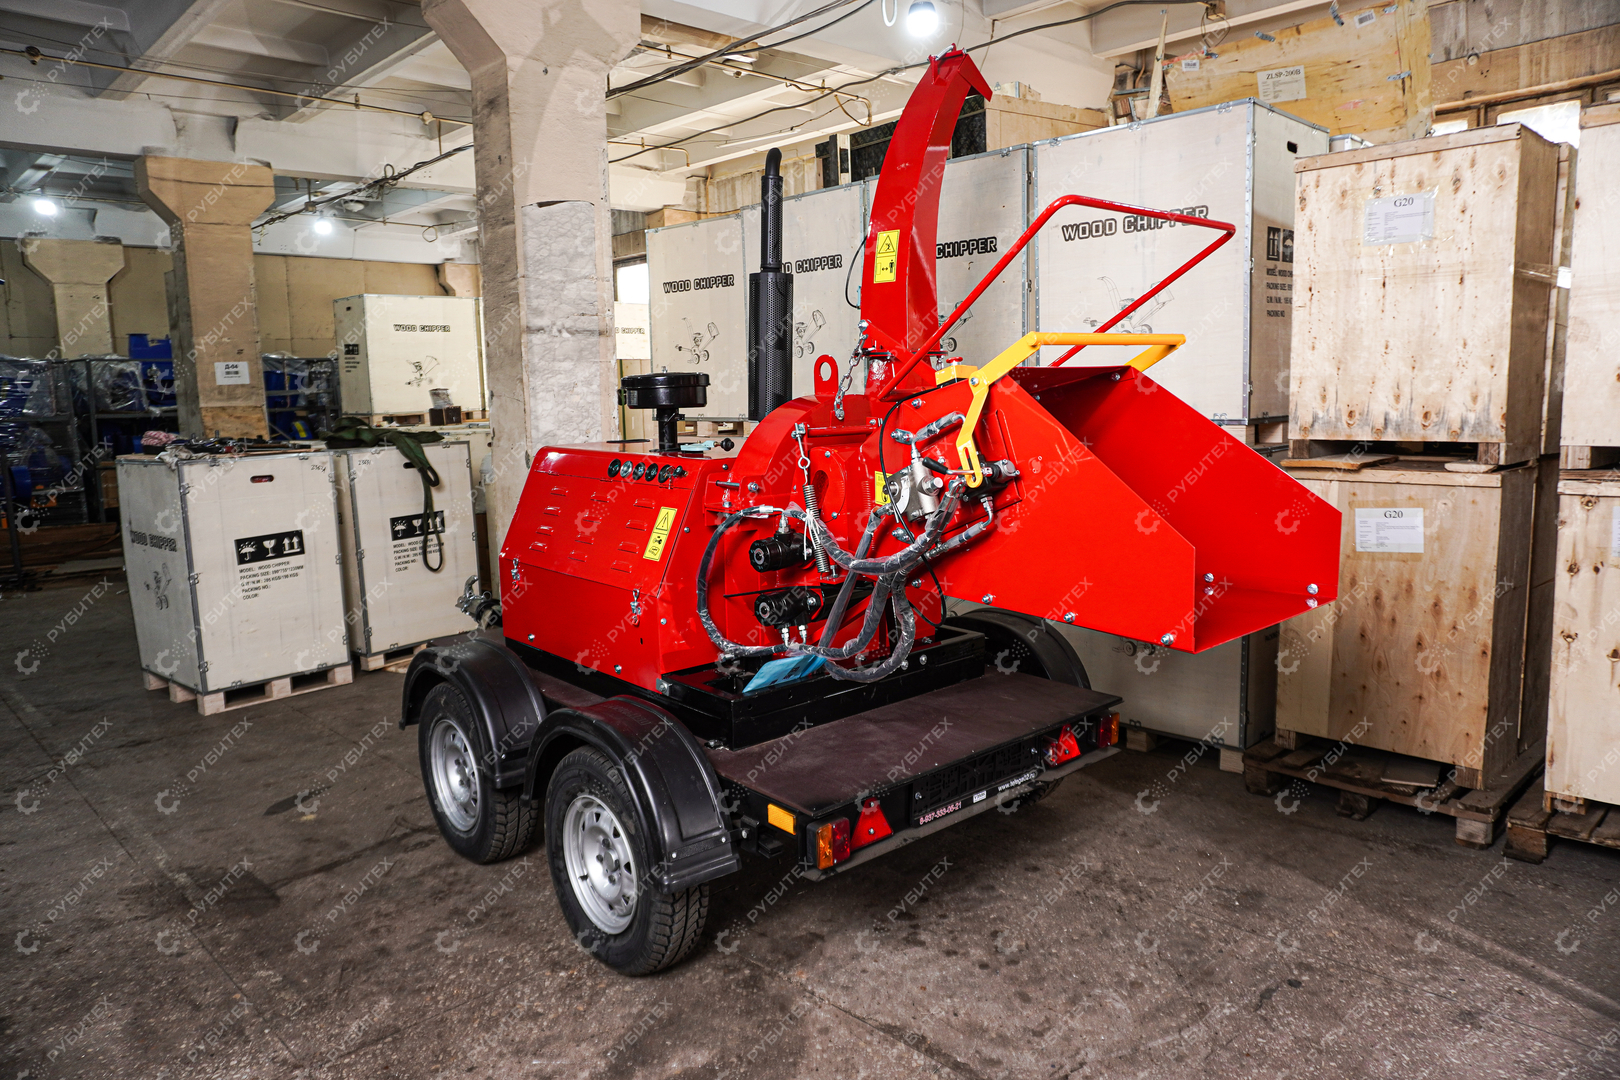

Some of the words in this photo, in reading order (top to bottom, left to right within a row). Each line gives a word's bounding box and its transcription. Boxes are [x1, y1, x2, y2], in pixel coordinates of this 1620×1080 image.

[1394, 197, 1414, 207] G20
[1062, 217, 1117, 242] WOOD
[936, 237, 998, 259] CHIPPER
[795, 254, 842, 274] CHIPPER
[662, 280, 692, 294] WOOD
[693, 274, 735, 291] CHIPPER
[393, 324, 417, 332] WOOD
[419, 325, 451, 333] CHIPPER
[1384, 510, 1404, 519] G20
[242, 585, 261, 593] PACKING
